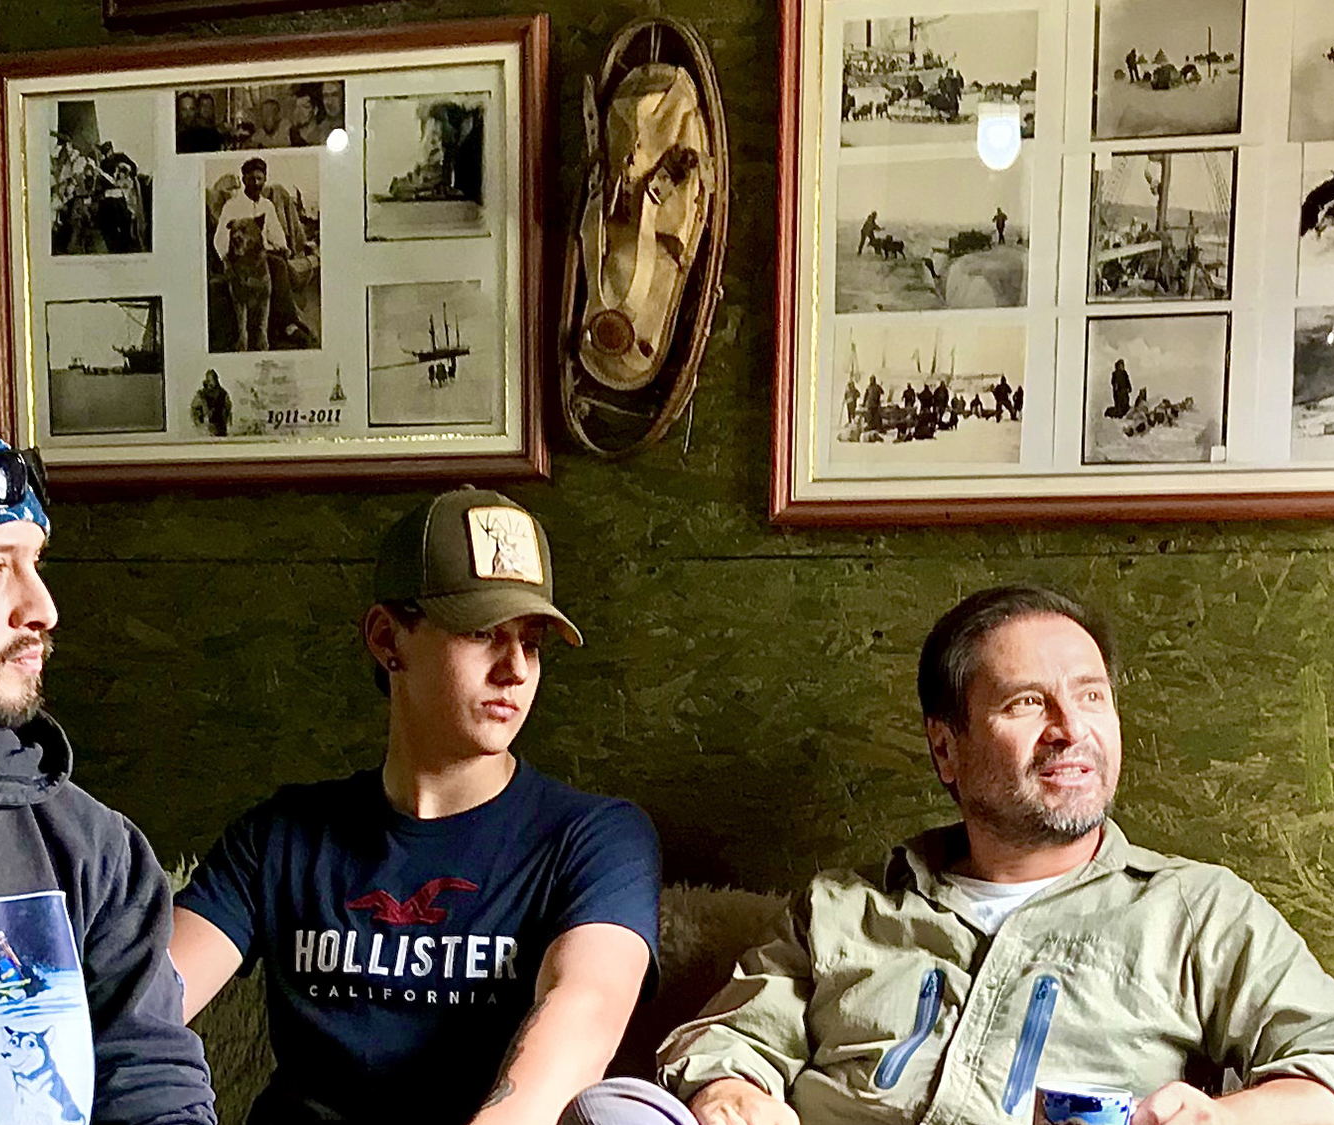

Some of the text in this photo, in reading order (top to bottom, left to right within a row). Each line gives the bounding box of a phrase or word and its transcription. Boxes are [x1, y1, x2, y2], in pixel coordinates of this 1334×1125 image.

[267, 408, 341, 430] 1911-2011
[295, 929, 518, 980] HOLLISTER
[309, 984, 498, 1005] CALIFORNIA
